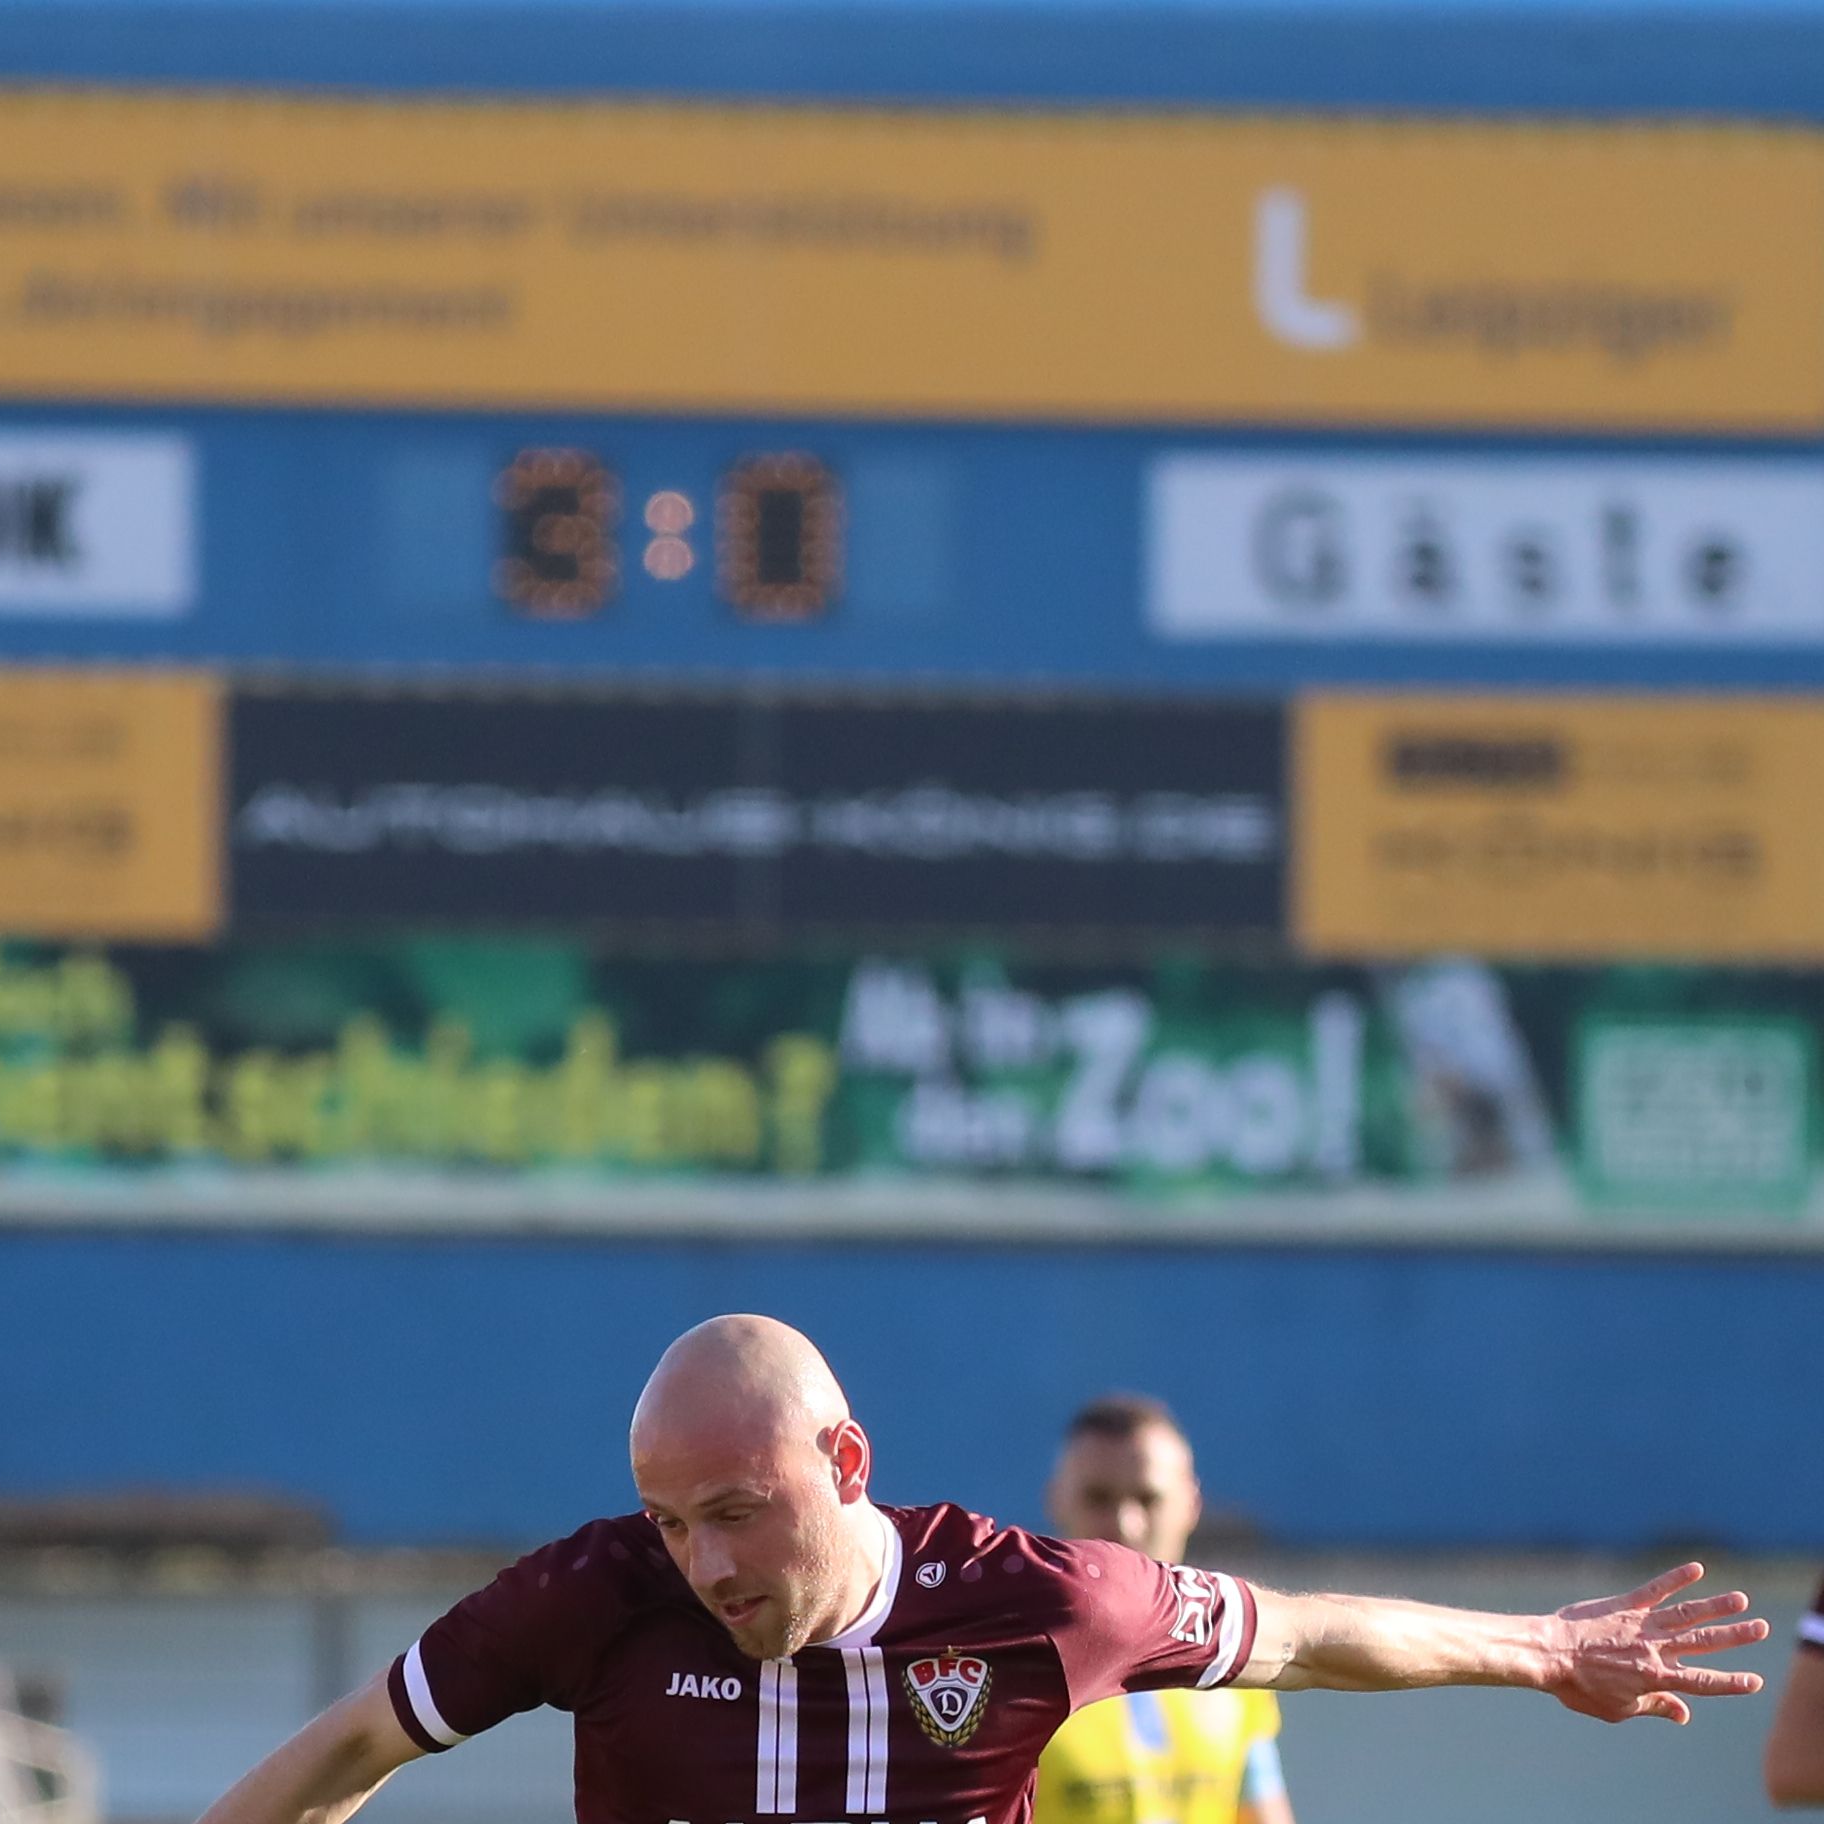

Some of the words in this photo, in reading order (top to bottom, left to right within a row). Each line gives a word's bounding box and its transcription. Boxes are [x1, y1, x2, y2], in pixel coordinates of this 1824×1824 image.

[1254, 482, 1746, 608] Gäste
[1056, 988, 1362, 1176] Zoo!
[665, 1672, 742, 1701] JAKO
[911, 1658, 984, 1687] BFC
